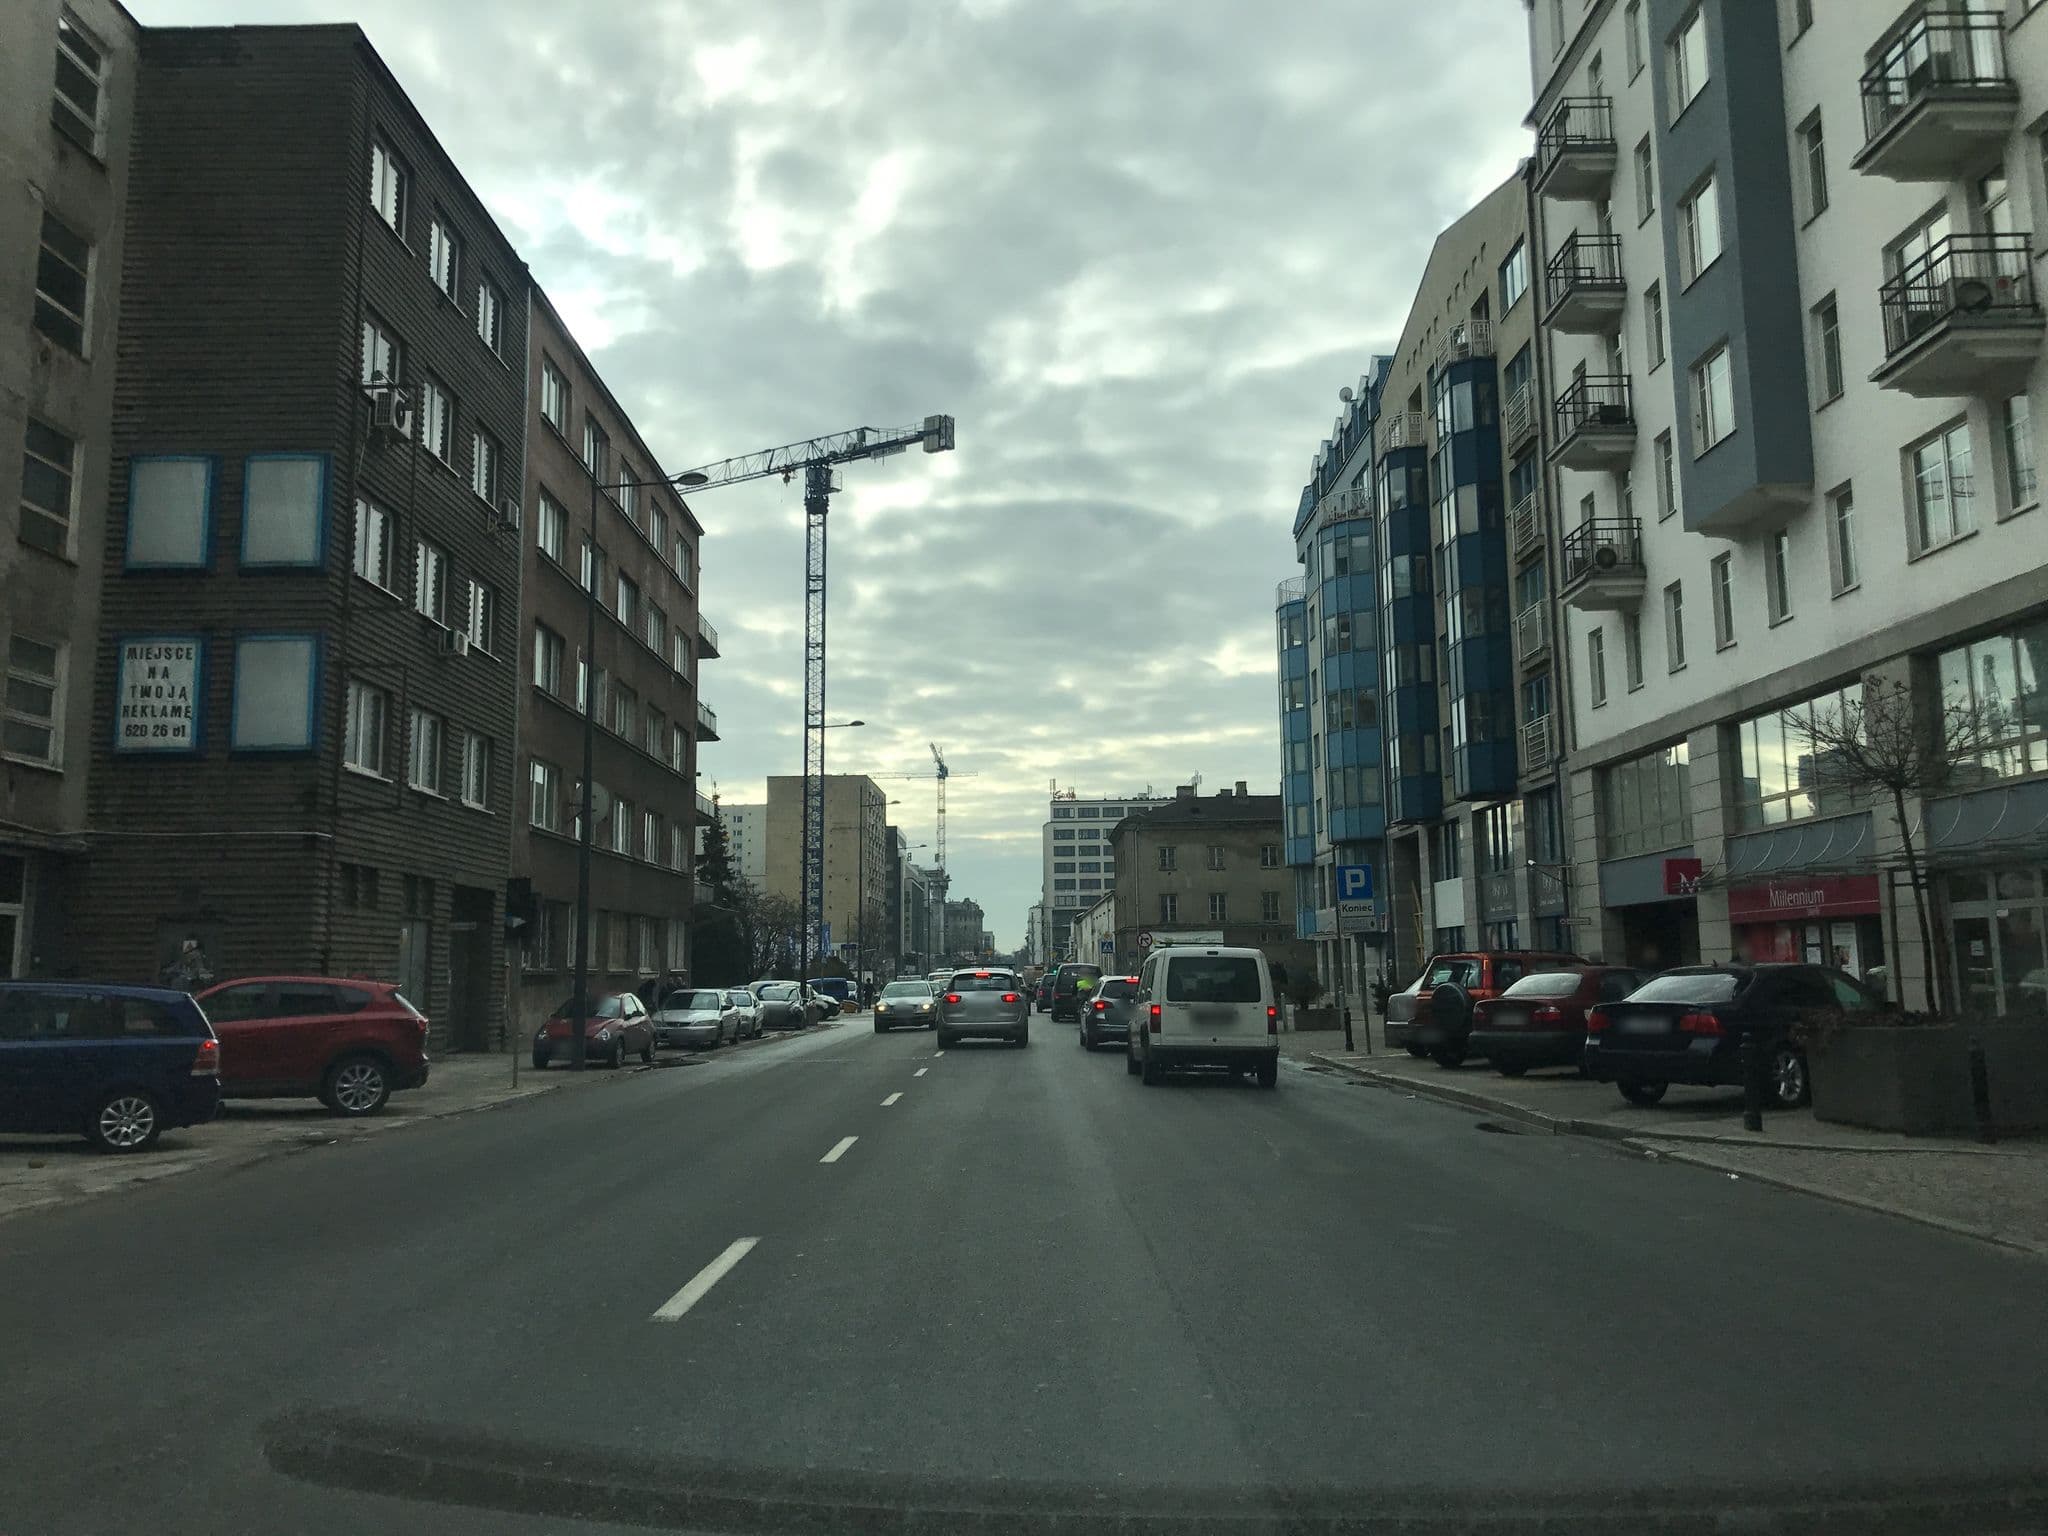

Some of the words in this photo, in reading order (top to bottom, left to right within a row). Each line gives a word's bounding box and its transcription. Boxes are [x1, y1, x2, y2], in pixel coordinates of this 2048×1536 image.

[127, 647, 193, 660] MIEJSCE
[147, 666, 169, 679] NA
[130, 685, 187, 701] TWOJĄ
[125, 724, 148, 737] 620
[152, 724, 168, 737] 26
[1345, 869, 1366, 896] P
[1768, 887, 1825, 908] Millennium
[1341, 904, 1373, 913] Koniec
